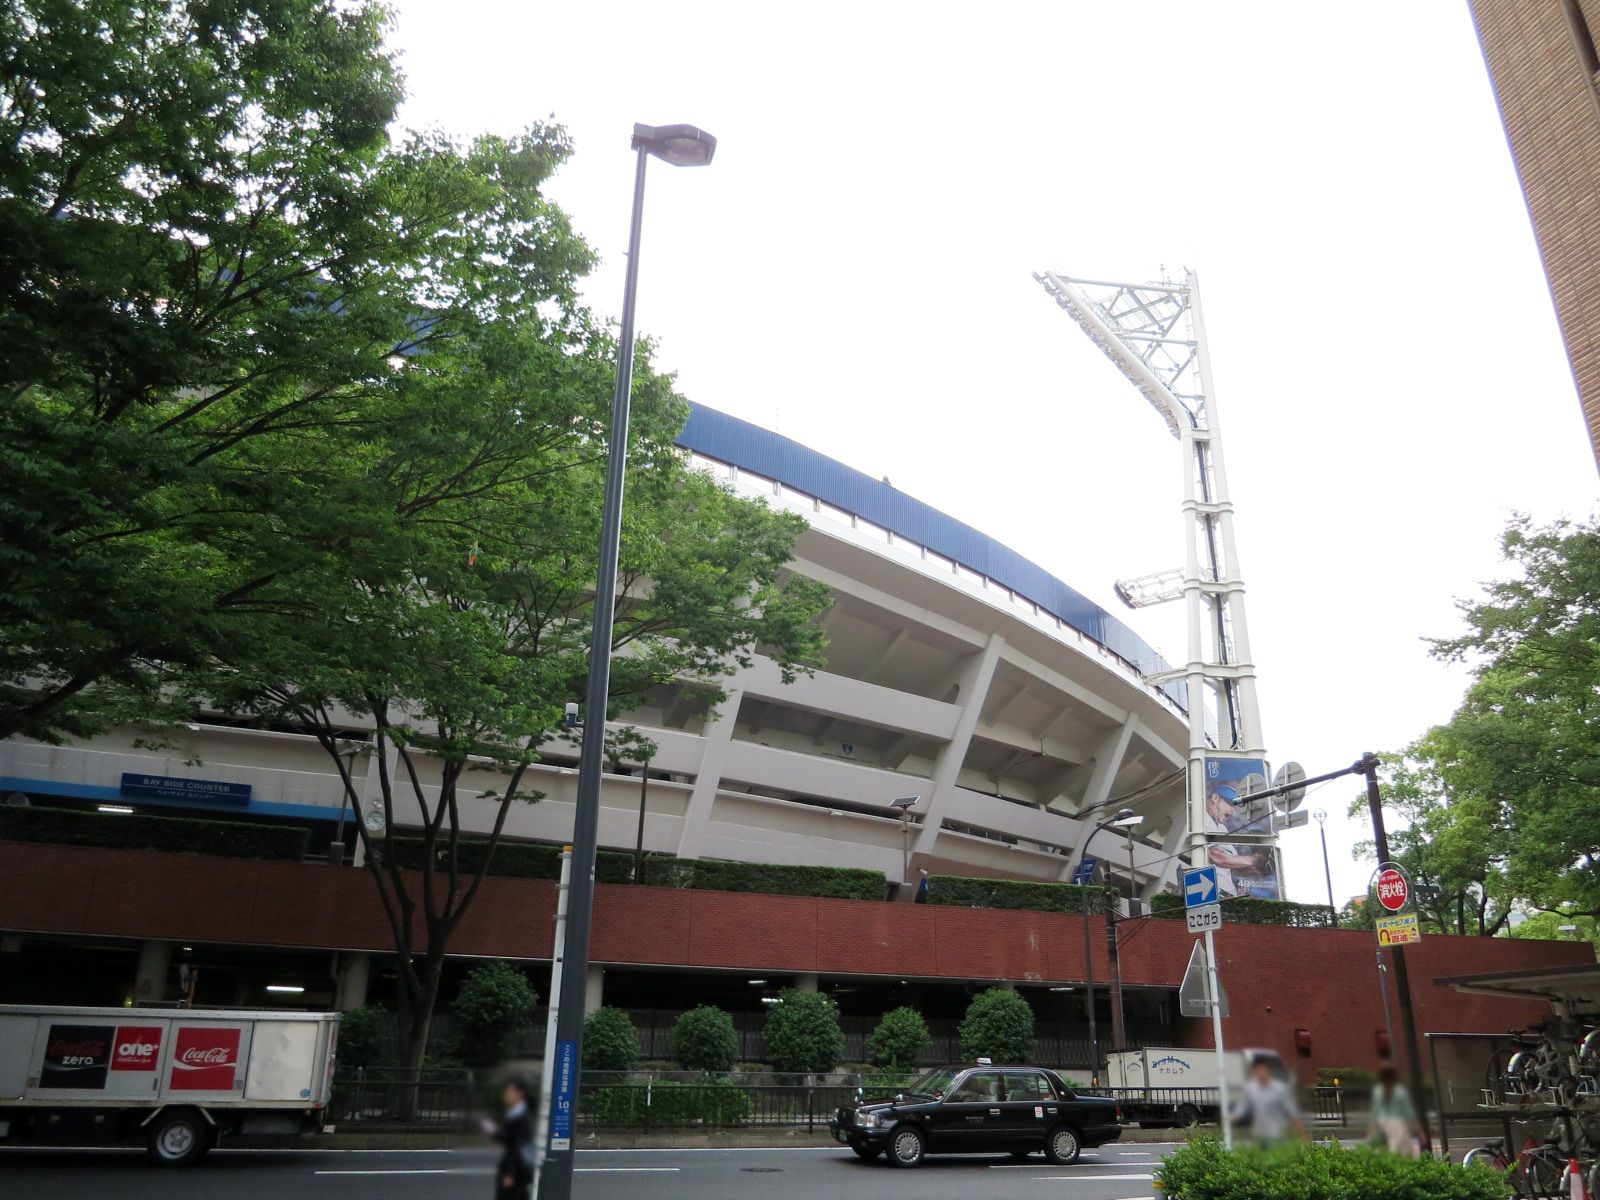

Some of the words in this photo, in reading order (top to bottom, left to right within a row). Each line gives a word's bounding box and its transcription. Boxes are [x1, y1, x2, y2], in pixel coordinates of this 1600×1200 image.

[163, 780, 185, 788] SIDE
[187, 782, 230, 792] COUNTER
[1380, 881, 1405, 899] 消火栓
[1189, 912, 1218, 927] ここから
[62, 1056, 94, 1065] zero
